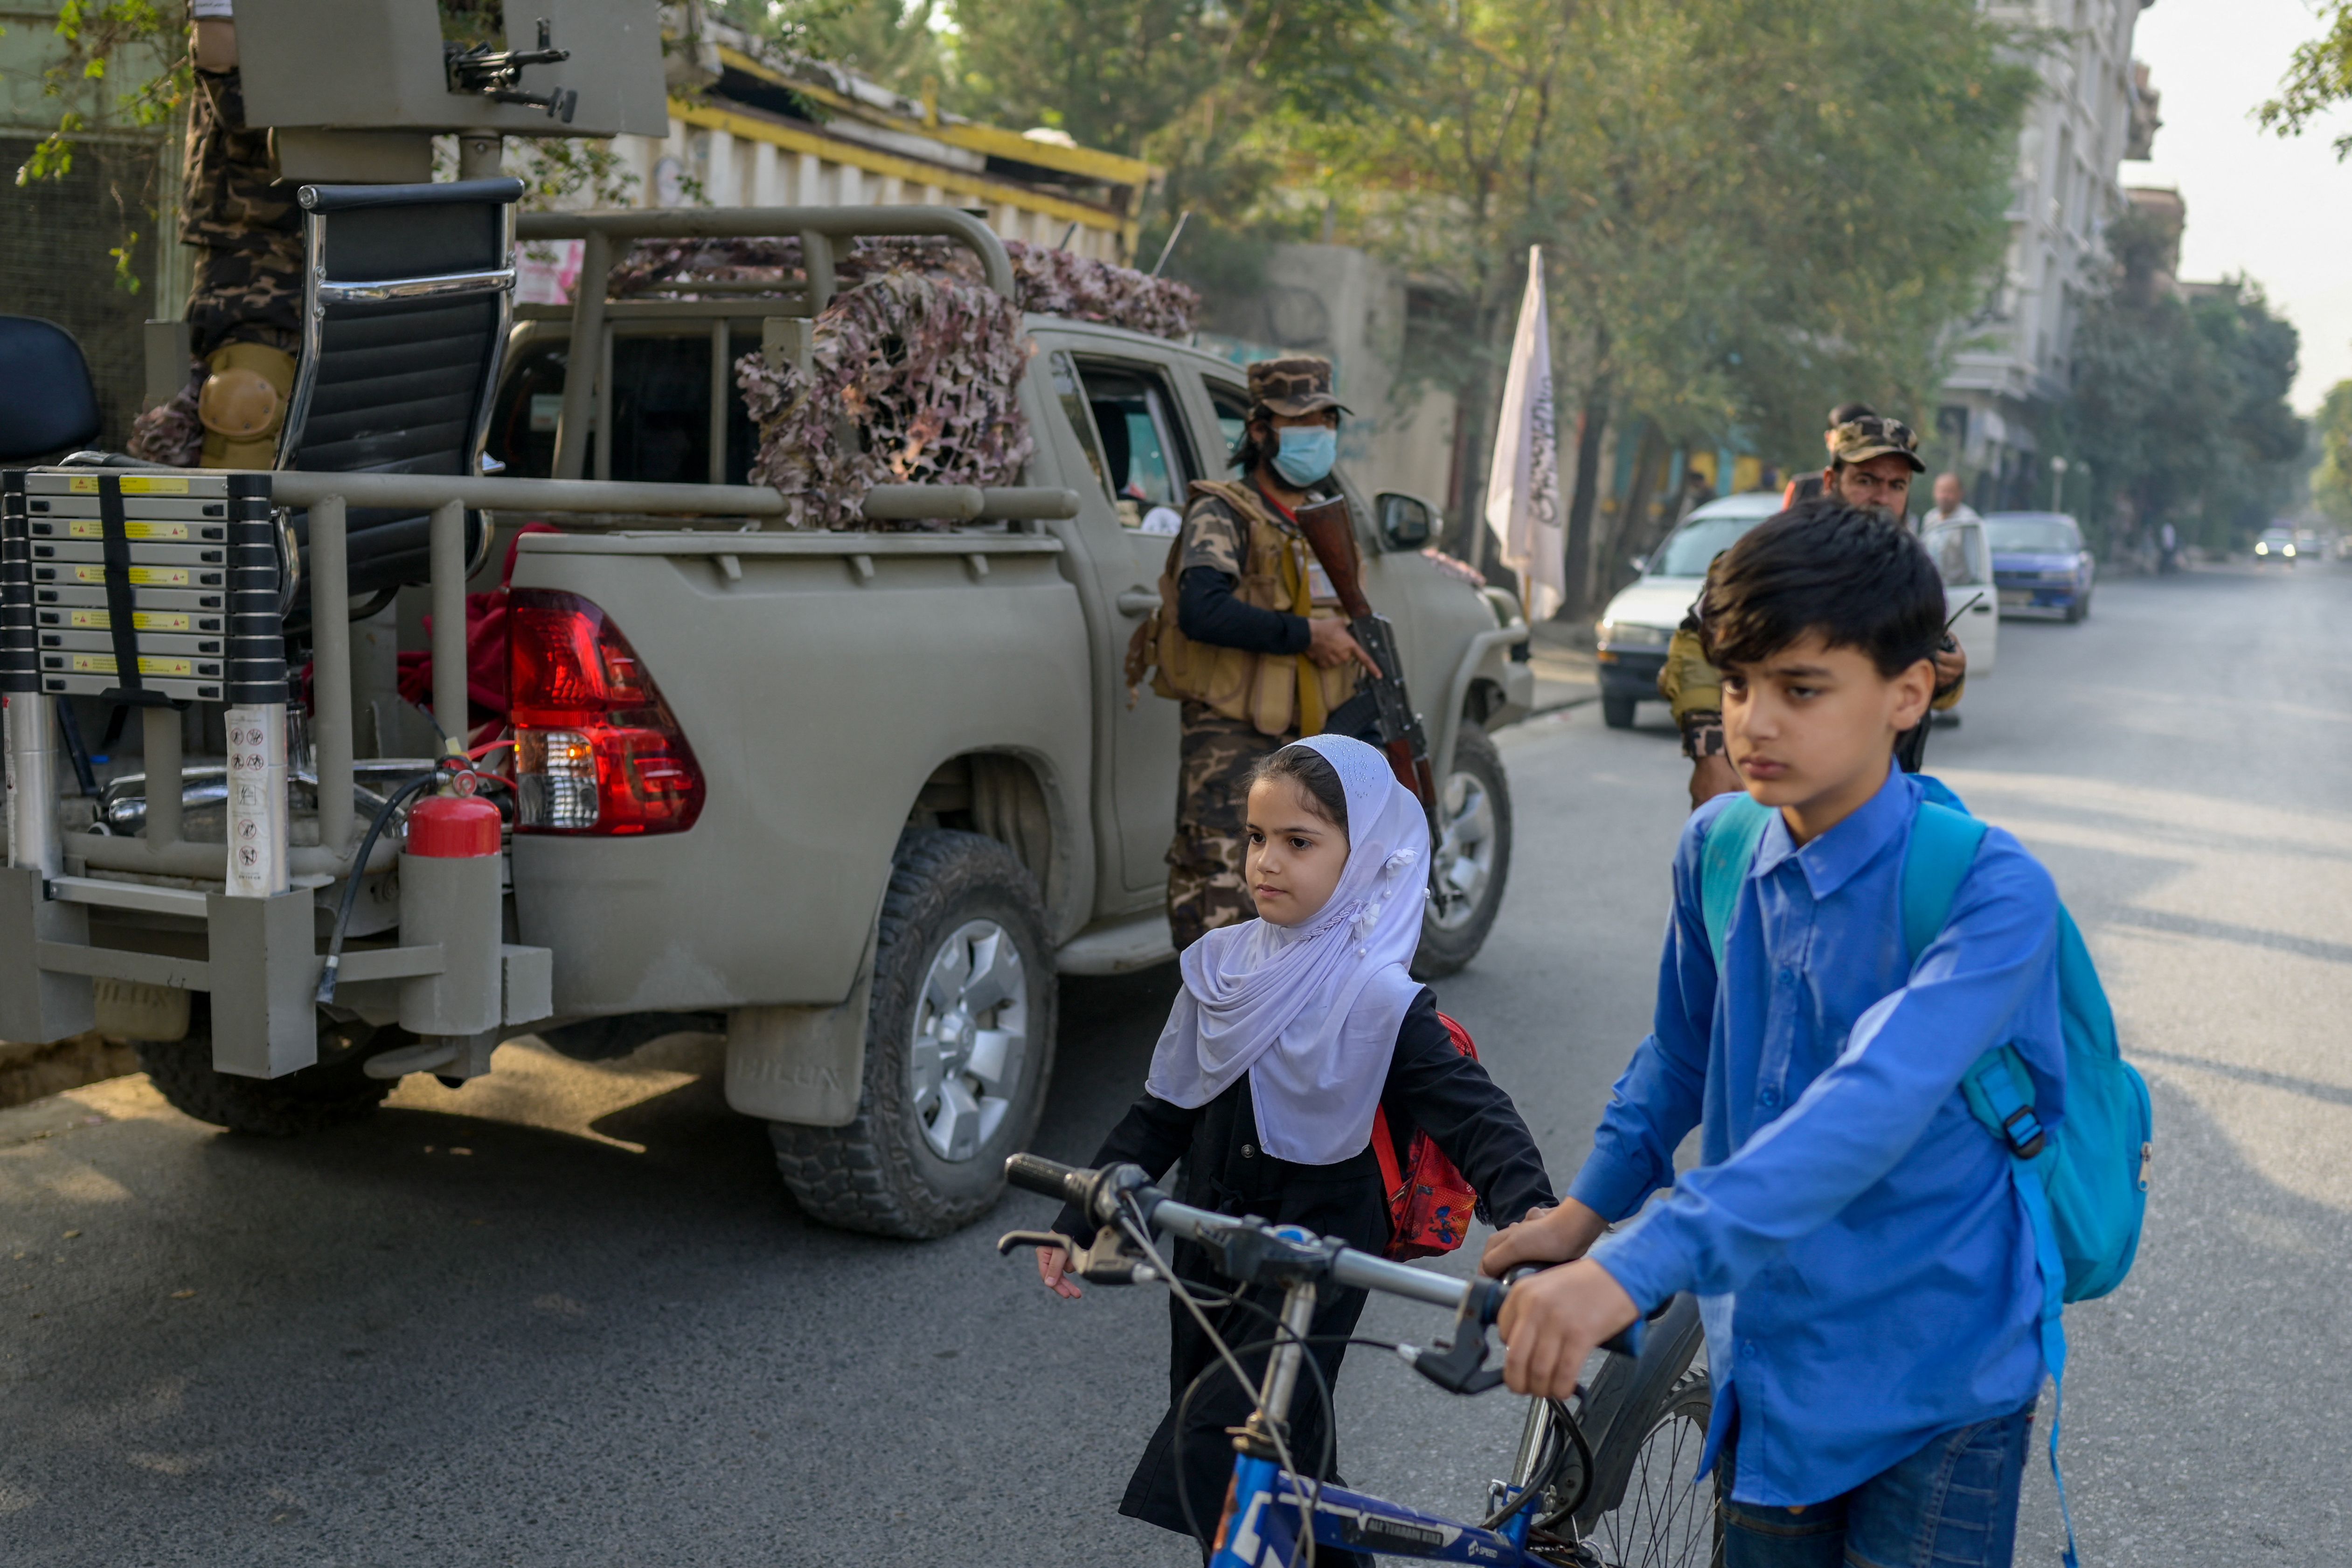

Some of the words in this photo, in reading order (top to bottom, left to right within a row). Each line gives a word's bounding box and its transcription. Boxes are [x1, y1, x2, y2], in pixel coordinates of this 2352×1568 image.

[735, 1057, 840, 1091] HILUX
[1367, 1519, 1383, 1533] ALL
[1385, 1521, 1421, 1541] TERRAIN
[1422, 1530, 1442, 1545] BIKE
[1479, 1546, 1498, 1558] SPEED
